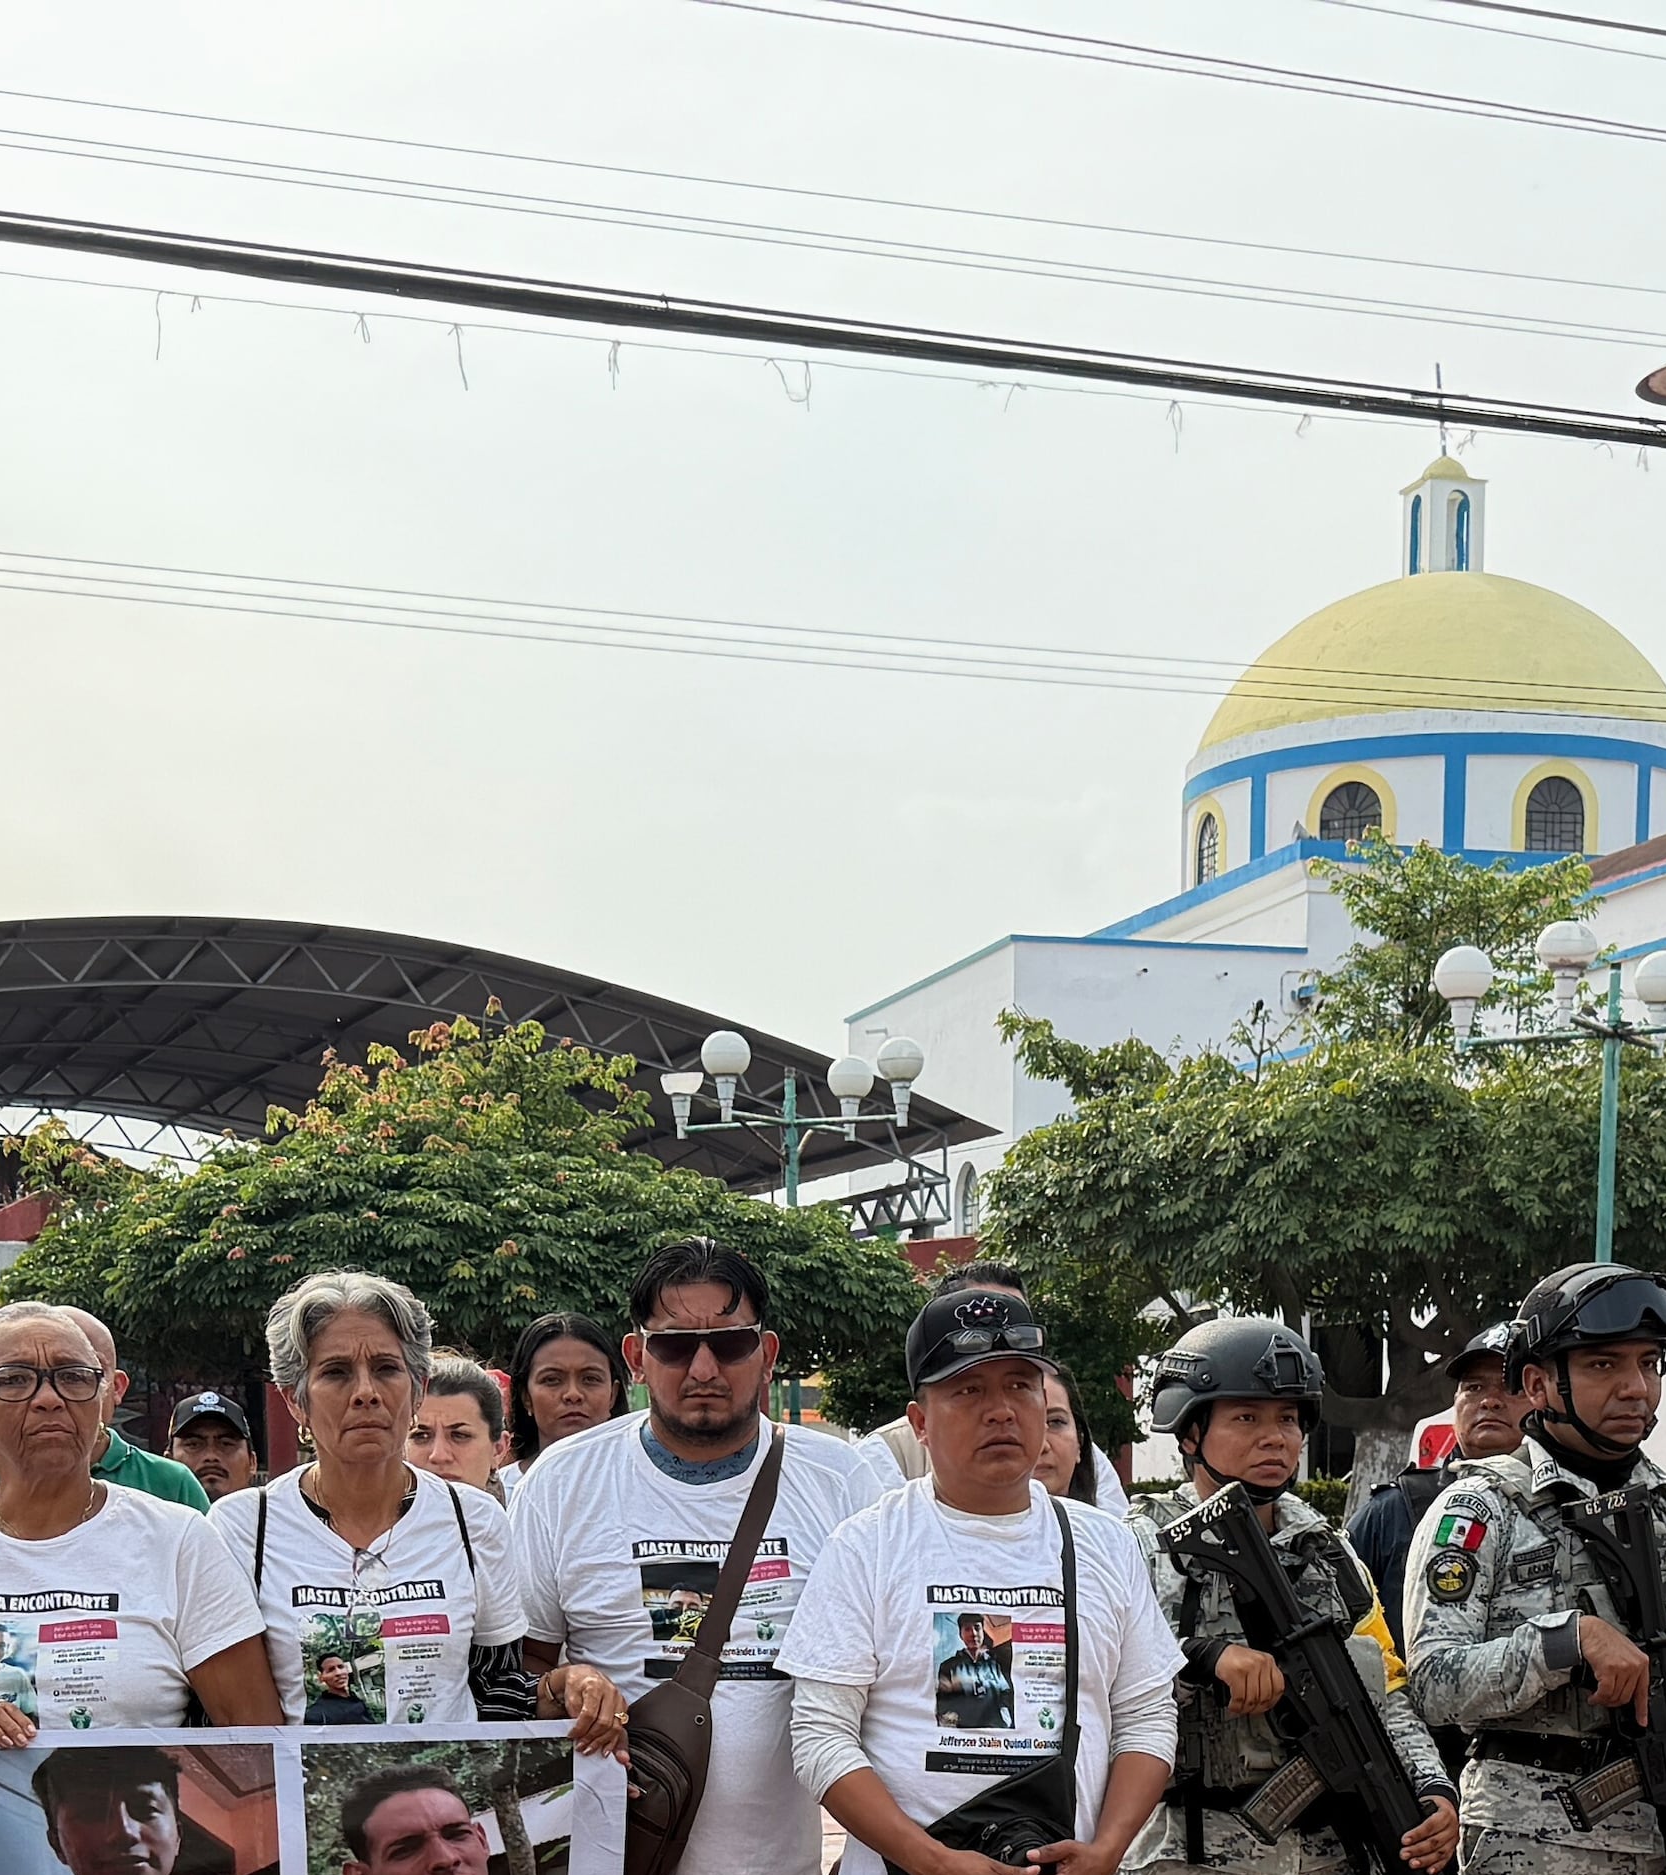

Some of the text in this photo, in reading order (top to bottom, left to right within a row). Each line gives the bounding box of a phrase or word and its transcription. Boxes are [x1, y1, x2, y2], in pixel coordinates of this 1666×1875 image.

[1170, 1521, 1192, 1543] 55
[637, 1541, 681, 1557] HASTA
[9, 1592, 110, 1612] ENCONTRARTE
[297, 1587, 342, 1605] HASTA
[933, 1586, 976, 1603] HASTA
[722, 1647, 756, 1656] ernández
